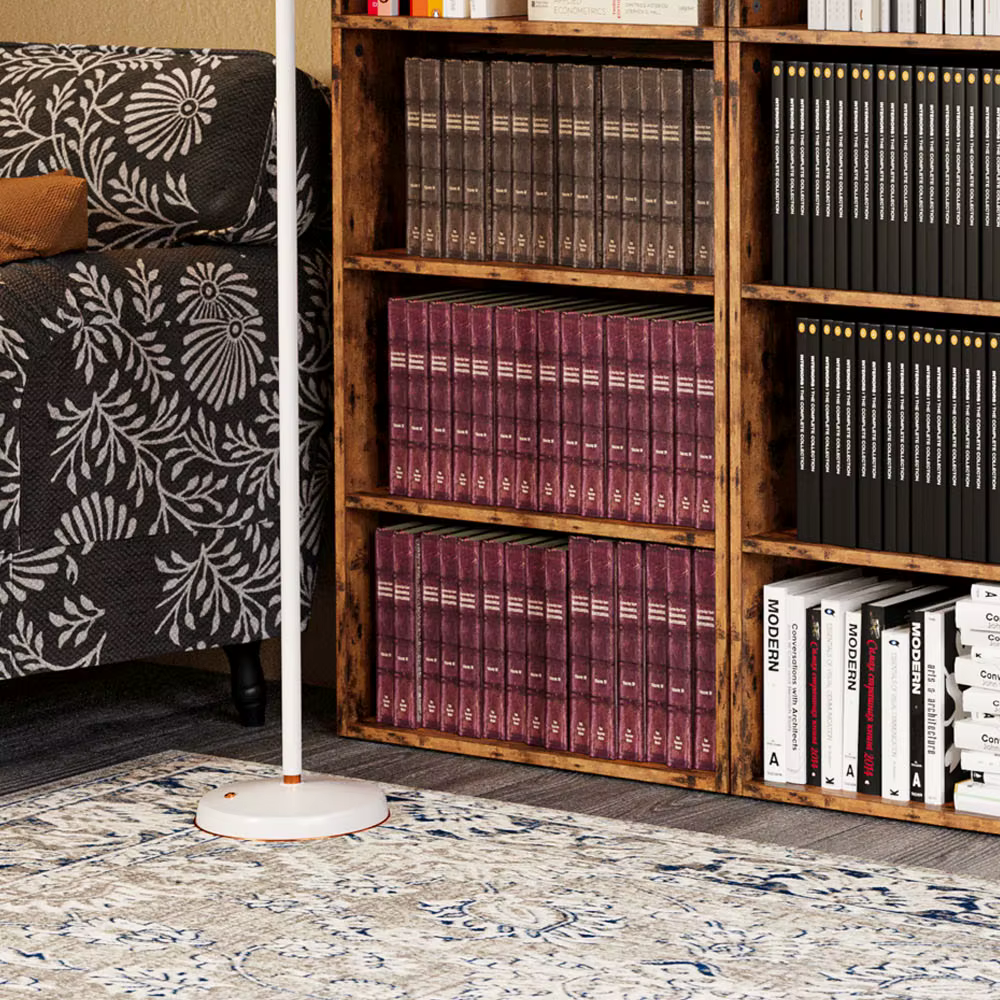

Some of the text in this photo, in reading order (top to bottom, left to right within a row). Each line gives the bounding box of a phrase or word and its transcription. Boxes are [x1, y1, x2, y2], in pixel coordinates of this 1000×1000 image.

[768, 599, 779, 672] MODERN
[848, 624, 858, 691] MODERN
[911, 622, 921, 695] MODERN
[927, 664, 937, 755] arts architecture
[769, 752, 779, 766] A
[913, 772, 921, 787] A
